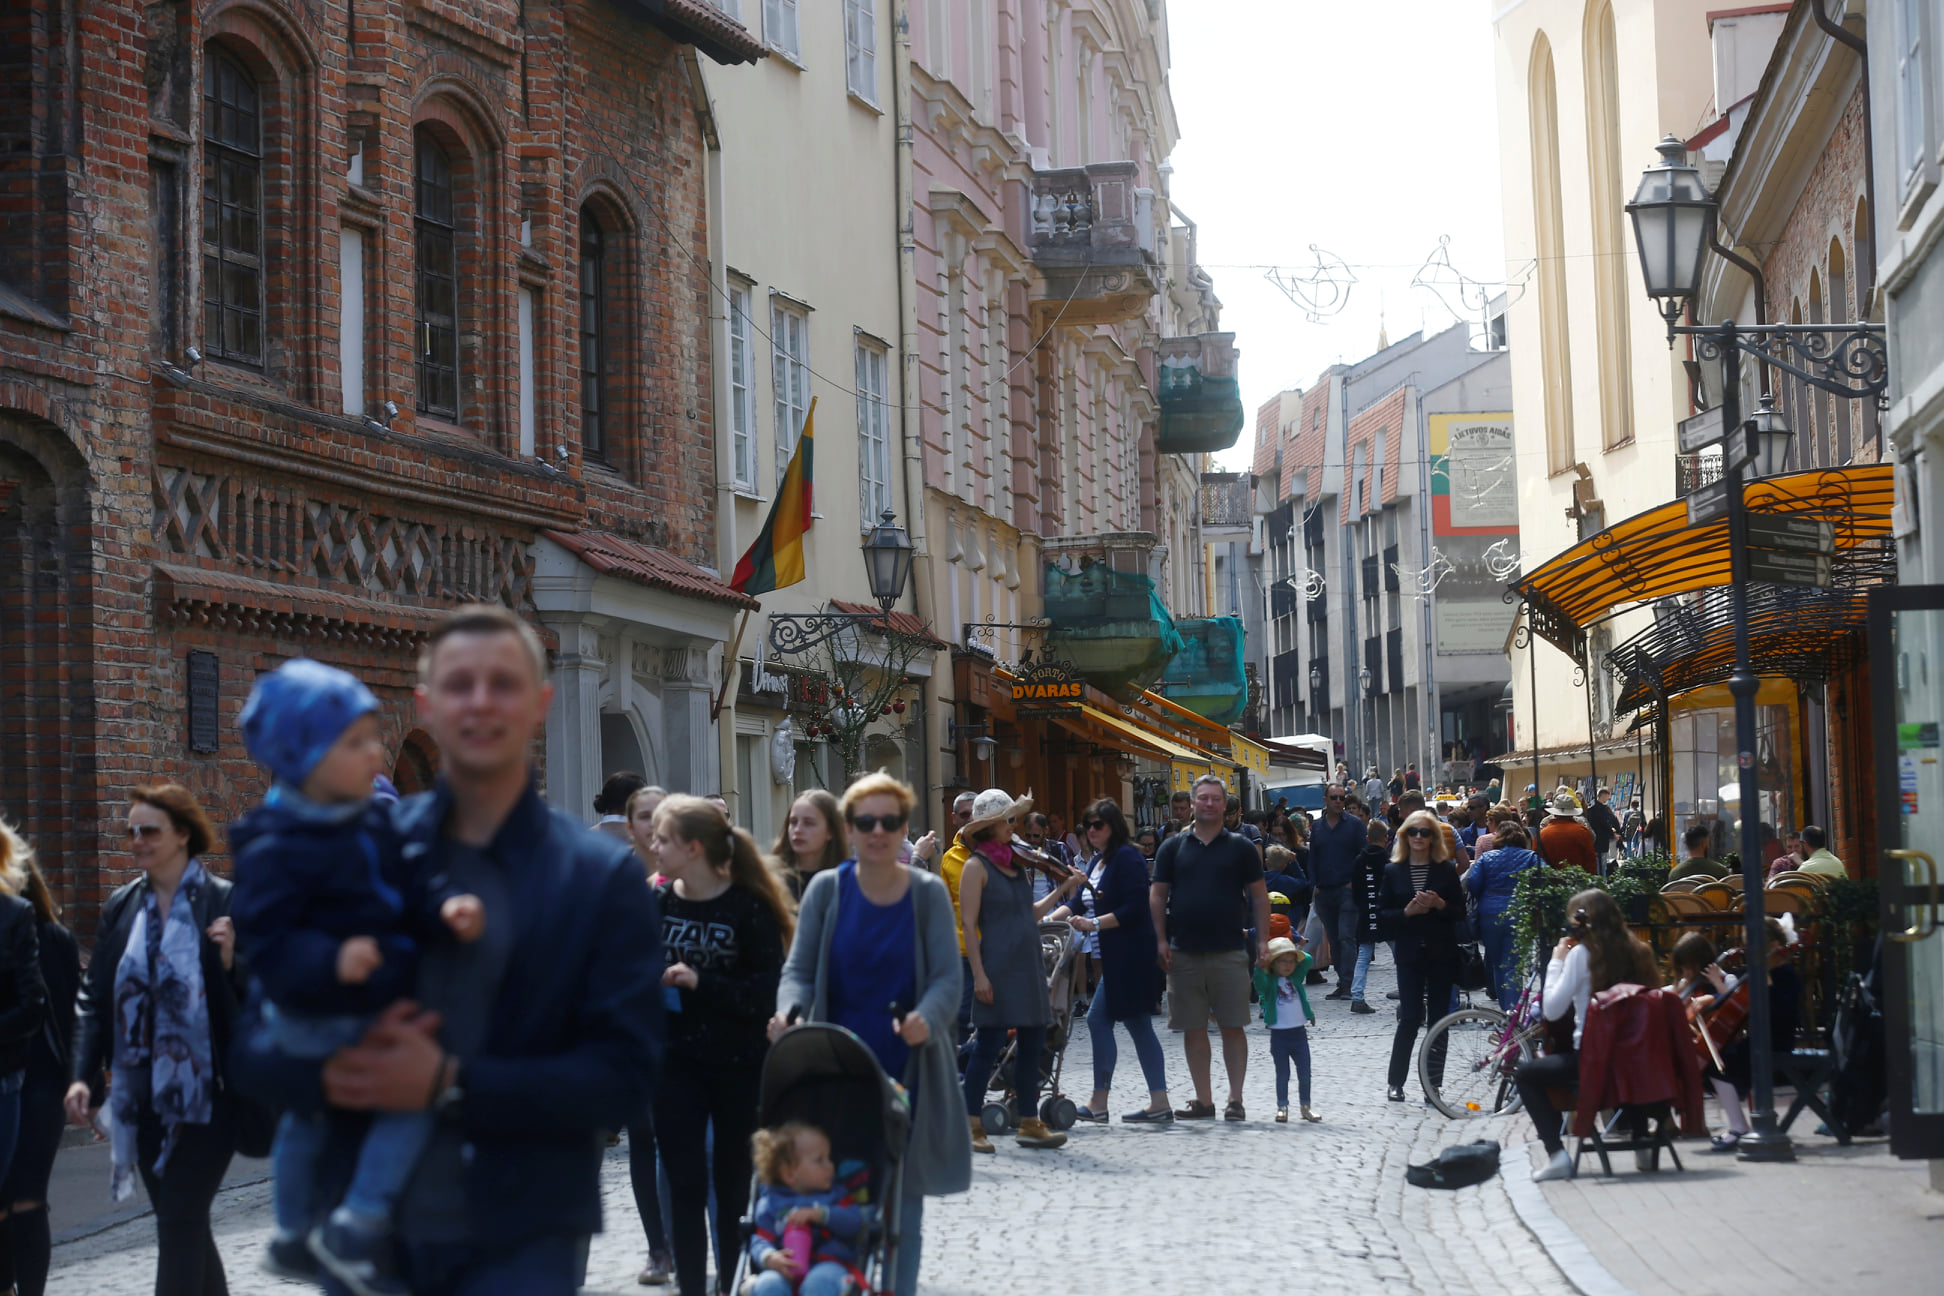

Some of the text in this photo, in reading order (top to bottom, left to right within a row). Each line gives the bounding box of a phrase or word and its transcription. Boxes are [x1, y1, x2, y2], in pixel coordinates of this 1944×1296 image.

[1031, 667, 1066, 683] PORTO
[1012, 683, 1082, 699] DVARAS
[660, 914, 736, 953] TAR
